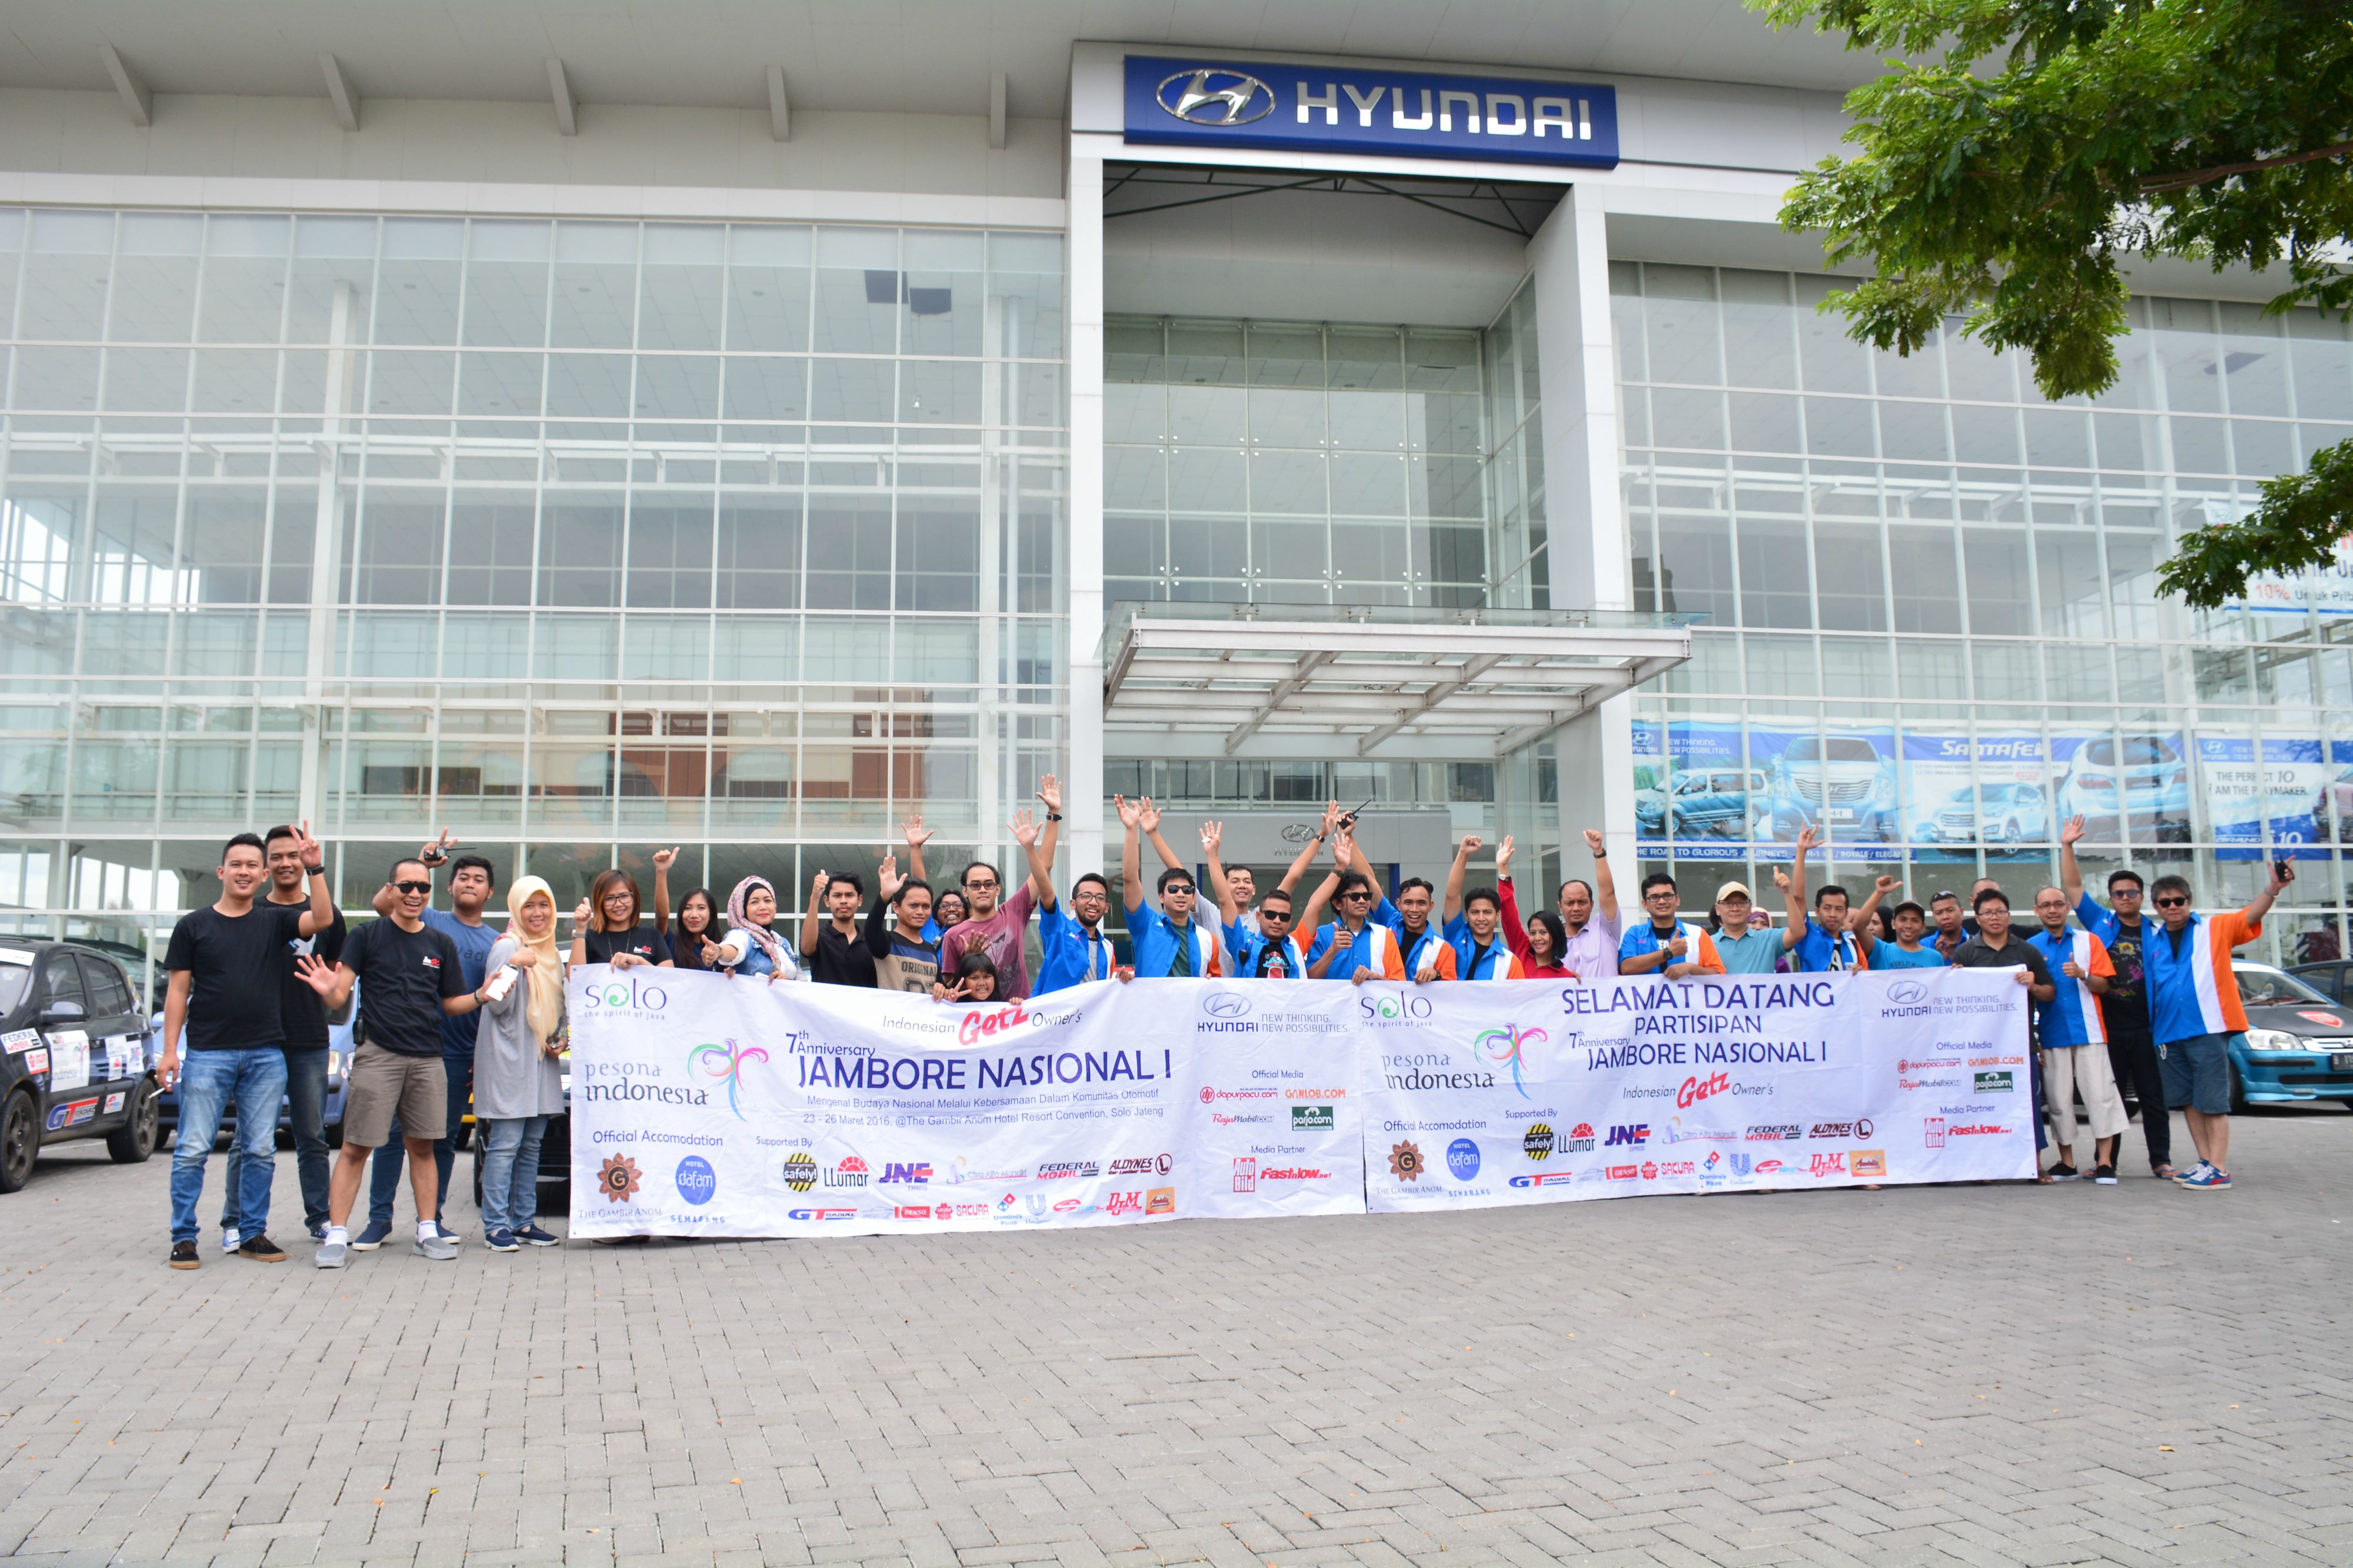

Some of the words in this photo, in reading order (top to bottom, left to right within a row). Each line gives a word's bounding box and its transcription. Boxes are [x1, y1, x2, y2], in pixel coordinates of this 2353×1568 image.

[1296, 81, 1591, 140] HYUNDAI
[2257, 583, 2291, 600] 10%
[2217, 772, 2233, 781] THE
[2235, 772, 2272, 781] PERFCT
[2215, 786, 2231, 795] AM
[2232, 786, 2249, 795] THE
[2251, 786, 2307, 795] PAYMAKER.
[1562, 983, 1694, 1014] SELAMAT
[1705, 982, 1835, 1009] DATANG
[1934, 997, 1953, 1006] NEW
[604, 1009, 631, 1017] spirit
[646, 1012, 665, 1020] java
[1882, 1006, 1932, 1018] HYUNDAI
[1934, 1006, 1953, 1015] NEW
[1956, 1003, 2018, 1014] POSSIBILITIES.
[1262, 1013, 1283, 1022] NEW
[1286, 1013, 1331, 1023] THINKING.
[882, 1015, 955, 1033] Indonesian
[958, 1005, 1029, 1046] Getz
[1032, 1009, 1082, 1027] Owner's
[1198, 1022, 1259, 1032] HYUNDAI
[1262, 1024, 1283, 1032] NEW
[1286, 1024, 1350, 1033] POSSIBILITIES.
[1634, 1015, 1762, 1036] PARTISIPAN
[3, 1030, 38, 1043] FEDERAL
[1578, 1036, 1631, 1048] Anniversary
[797, 1041, 875, 1059] Anniversary
[1937, 1042, 1965, 1050] Official
[1968, 1041, 1992, 1049] Media
[1381, 1053, 1451, 1071] pesona
[1587, 1043, 1687, 1071] JAMBORE
[1695, 1041, 1815, 1063] NASIONAL
[585, 1062, 662, 1082] pesona
[798, 1056, 966, 1090] JAMBORE
[978, 1050, 1155, 1089] NASIONAL
[1164, 1049, 1171, 1079] I
[1252, 1070, 1279, 1079] Official
[1281, 1070, 1304, 1079] Media
[1385, 1068, 1495, 1090] indonesia
[584, 1077, 709, 1105] indonesia
[1217, 1089, 1278, 1101] dapurpacu.com
[1623, 1085, 1676, 1099] Indonesian
[1677, 1069, 1731, 1109] Getz
[1732, 1082, 1774, 1096] Owner's
[807, 1095, 851, 1107] Mengenal
[854, 1098, 889, 1110] Budaya
[892, 1099, 934, 1109] Nasional
[937, 1098, 971, 1108] Melalui
[974, 1096, 1036, 1107] Kebersamaan
[1039, 1093, 1069, 1104] Dalam
[1072, 1090, 1119, 1102] Komunitas
[1121, 1089, 1159, 1099] Otomotif
[804, 1114, 815, 1123] 23
[825, 1115, 837, 1123] 26
[839, 1115, 864, 1125] Maret
[928, 1115, 962, 1126] Gambir
[964, 1116, 992, 1125] Anom
[994, 1113, 1018, 1123] Hotel
[1022, 1112, 1053, 1122] Resort
[1055, 1110, 1108, 1120] Convention,
[1111, 1107, 1131, 1117] Solo
[1134, 1106, 1163, 1117] Jateng
[1505, 1110, 1546, 1119] Supported
[1548, 1108, 1558, 1118] By
[1939, 1106, 1965, 1115] Media
[1967, 1105, 1995, 1113] Partner
[1293, 1115, 1332, 1126] parjo.com
[1384, 1120, 1417, 1132] Official
[1419, 1119, 1487, 1131] Accomodation
[1747, 1125, 1802, 1133] FEDERAL
[1810, 1123, 1852, 1133] ALDYNES
[593, 1130, 637, 1143] Official
[641, 1130, 723, 1146] Accomodation
[756, 1136, 799, 1147] Supported
[801, 1137, 812, 1147] By
[1604, 1124, 1651, 1146] JNE
[1745, 1132, 1785, 1141] MOBIL
[1524, 1137, 1553, 1150] safely!
[1558, 1136, 1596, 1153] LLumar
[1109, 1157, 1153, 1170] ALDYNES
[1449, 1151, 1478, 1168] dafam
[878, 1162, 934, 1183] JNE
[1039, 1162, 1100, 1172] FEDERAL
[1661, 1161, 1695, 1175] SAKURA
[784, 1167, 817, 1182] safely!
[824, 1167, 869, 1187] LLumar
[1036, 1170, 1081, 1180] MOBIL
[1449, 1188, 1491, 1197] SEMARANG
[956, 1204, 989, 1216] SAKURA
[671, 1215, 725, 1224] SEMARANG
